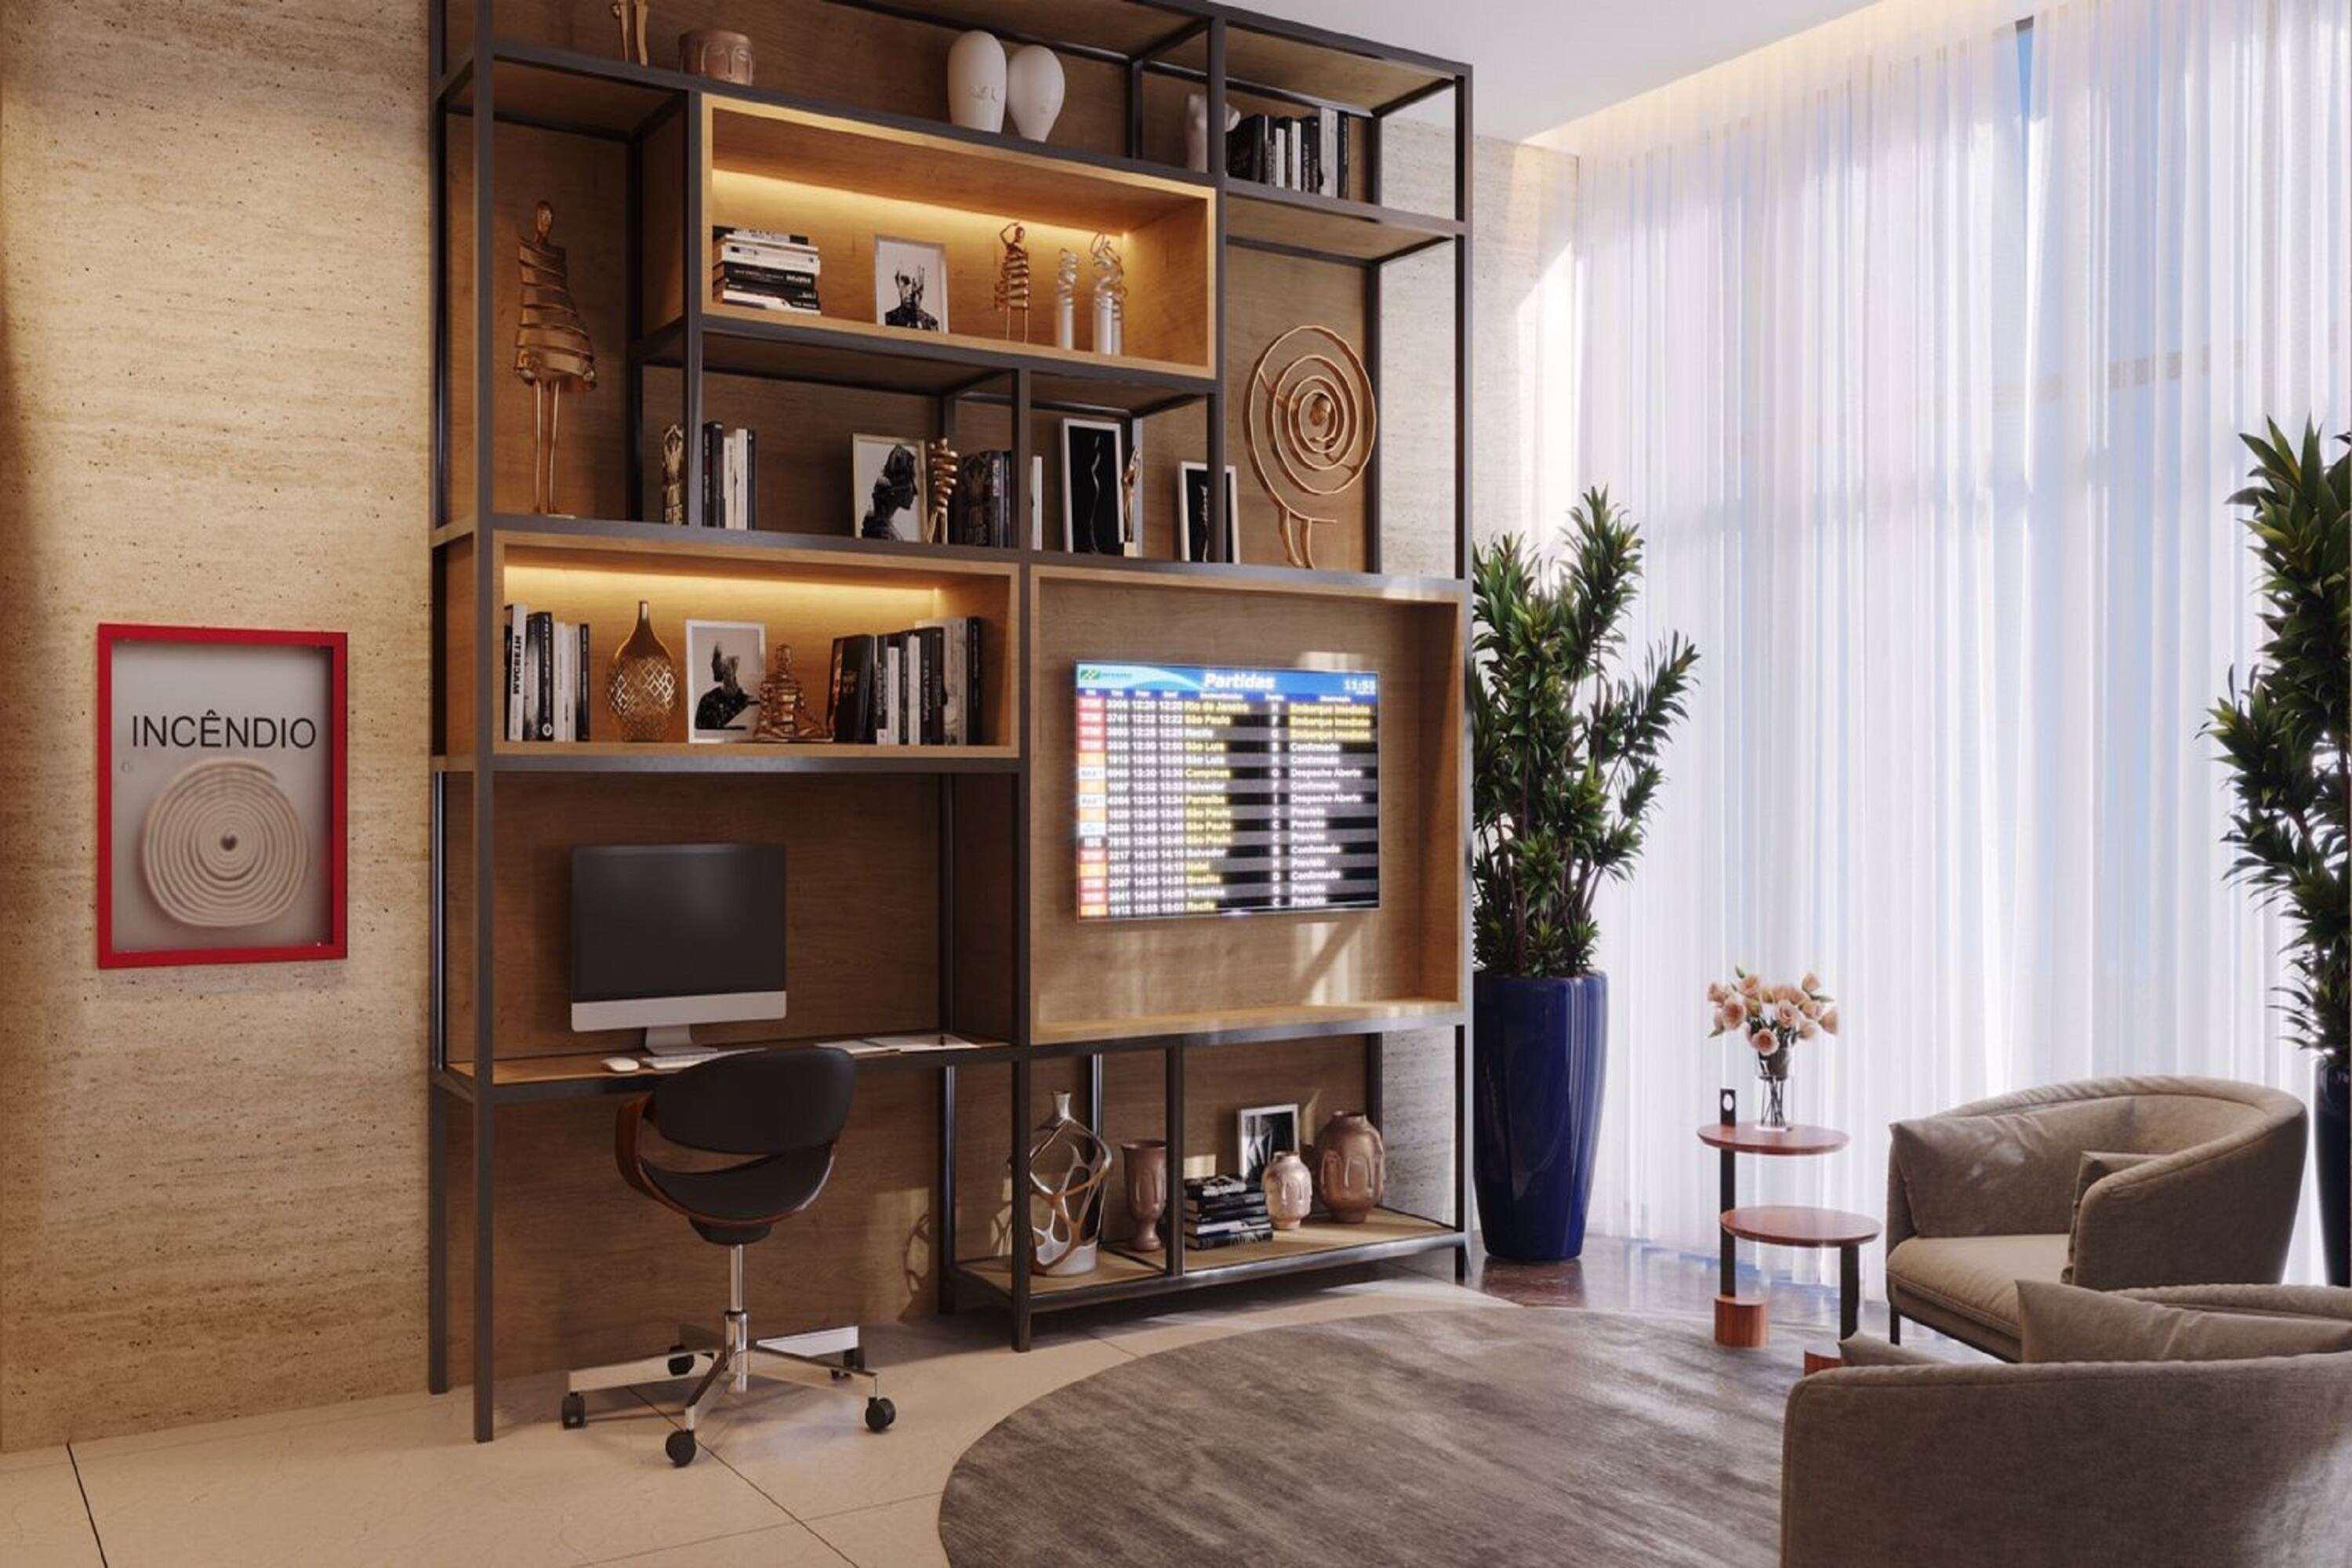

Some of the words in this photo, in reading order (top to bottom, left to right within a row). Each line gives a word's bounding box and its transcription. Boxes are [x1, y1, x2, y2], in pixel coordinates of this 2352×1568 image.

[1204, 672, 1275, 690] Partidas
[132, 709, 317, 750] INCÊNDIO
[1291, 742, 1340, 751] Confirmado
[1291, 755, 1340, 764] Confirmado
[1291, 781, 1340, 789] Confirmado
[1291, 844, 1340, 853] Confirmado
[1291, 871, 1340, 880] Confirmado
